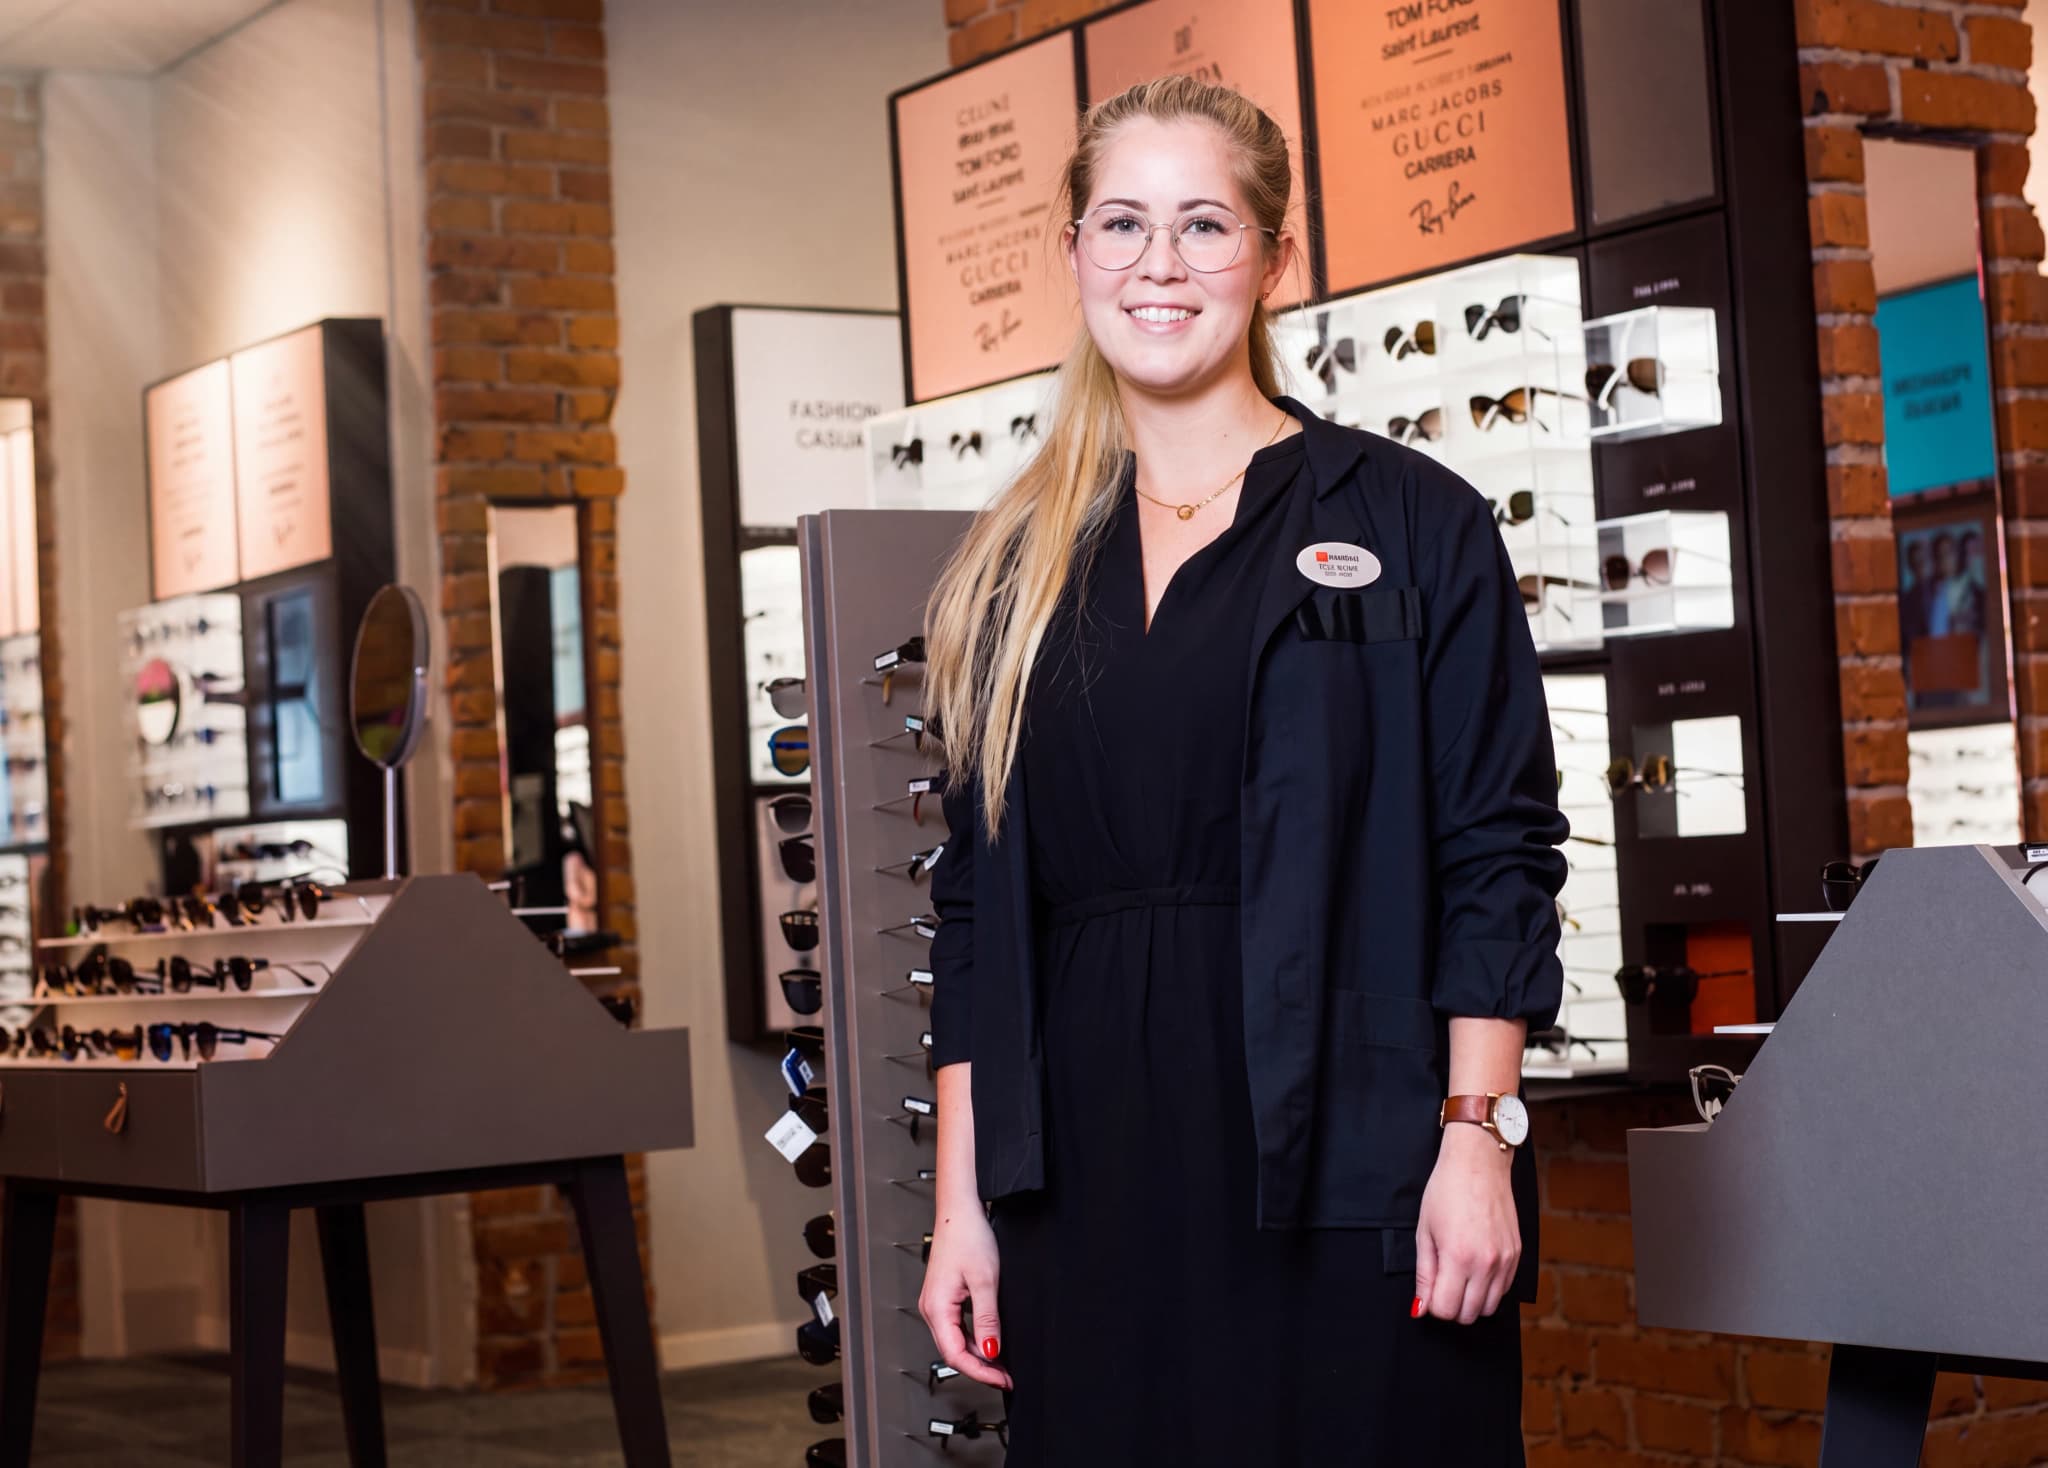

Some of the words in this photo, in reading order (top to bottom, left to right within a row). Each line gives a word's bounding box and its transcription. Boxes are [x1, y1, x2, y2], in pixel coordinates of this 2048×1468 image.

[1386, 1, 1422, 30] TOM
[1426, 0, 1475, 17] FO
[1371, 104, 1422, 132] MARC
[1392, 109, 1484, 157] GUCCI
[1404, 145, 1476, 180] CARRERA
[789, 399, 881, 421] FASHION
[795, 428, 865, 449] CASUA
